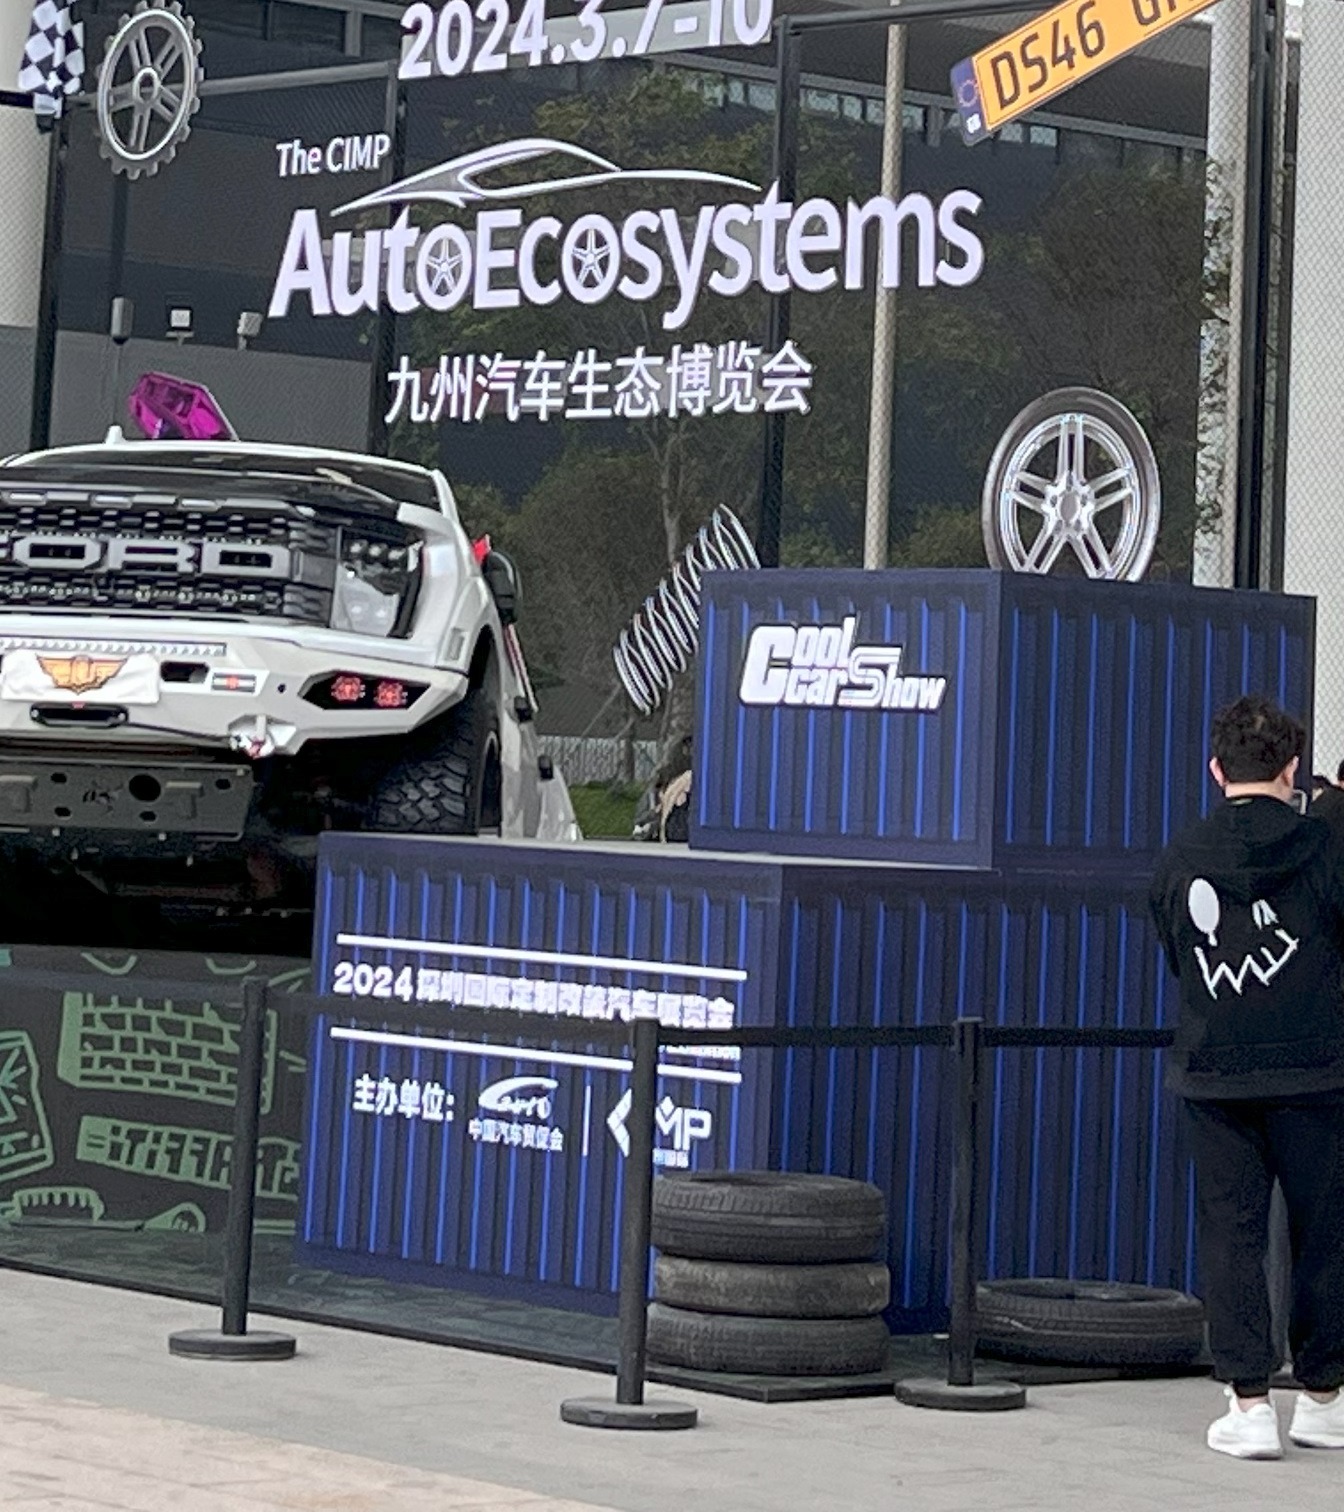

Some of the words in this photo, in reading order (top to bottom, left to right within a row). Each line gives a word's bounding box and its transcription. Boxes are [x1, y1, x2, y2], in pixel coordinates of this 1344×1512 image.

[991, 0, 1105, 110] DS46
[276, 140, 322, 177] The
[326, 134, 391, 173] CIMP
[267, 179, 985, 332] AutoEcosystems
[384, 338, 814, 426] 九州汽车生态博览会
[353, 1073, 455, 1122] 主办单位：
